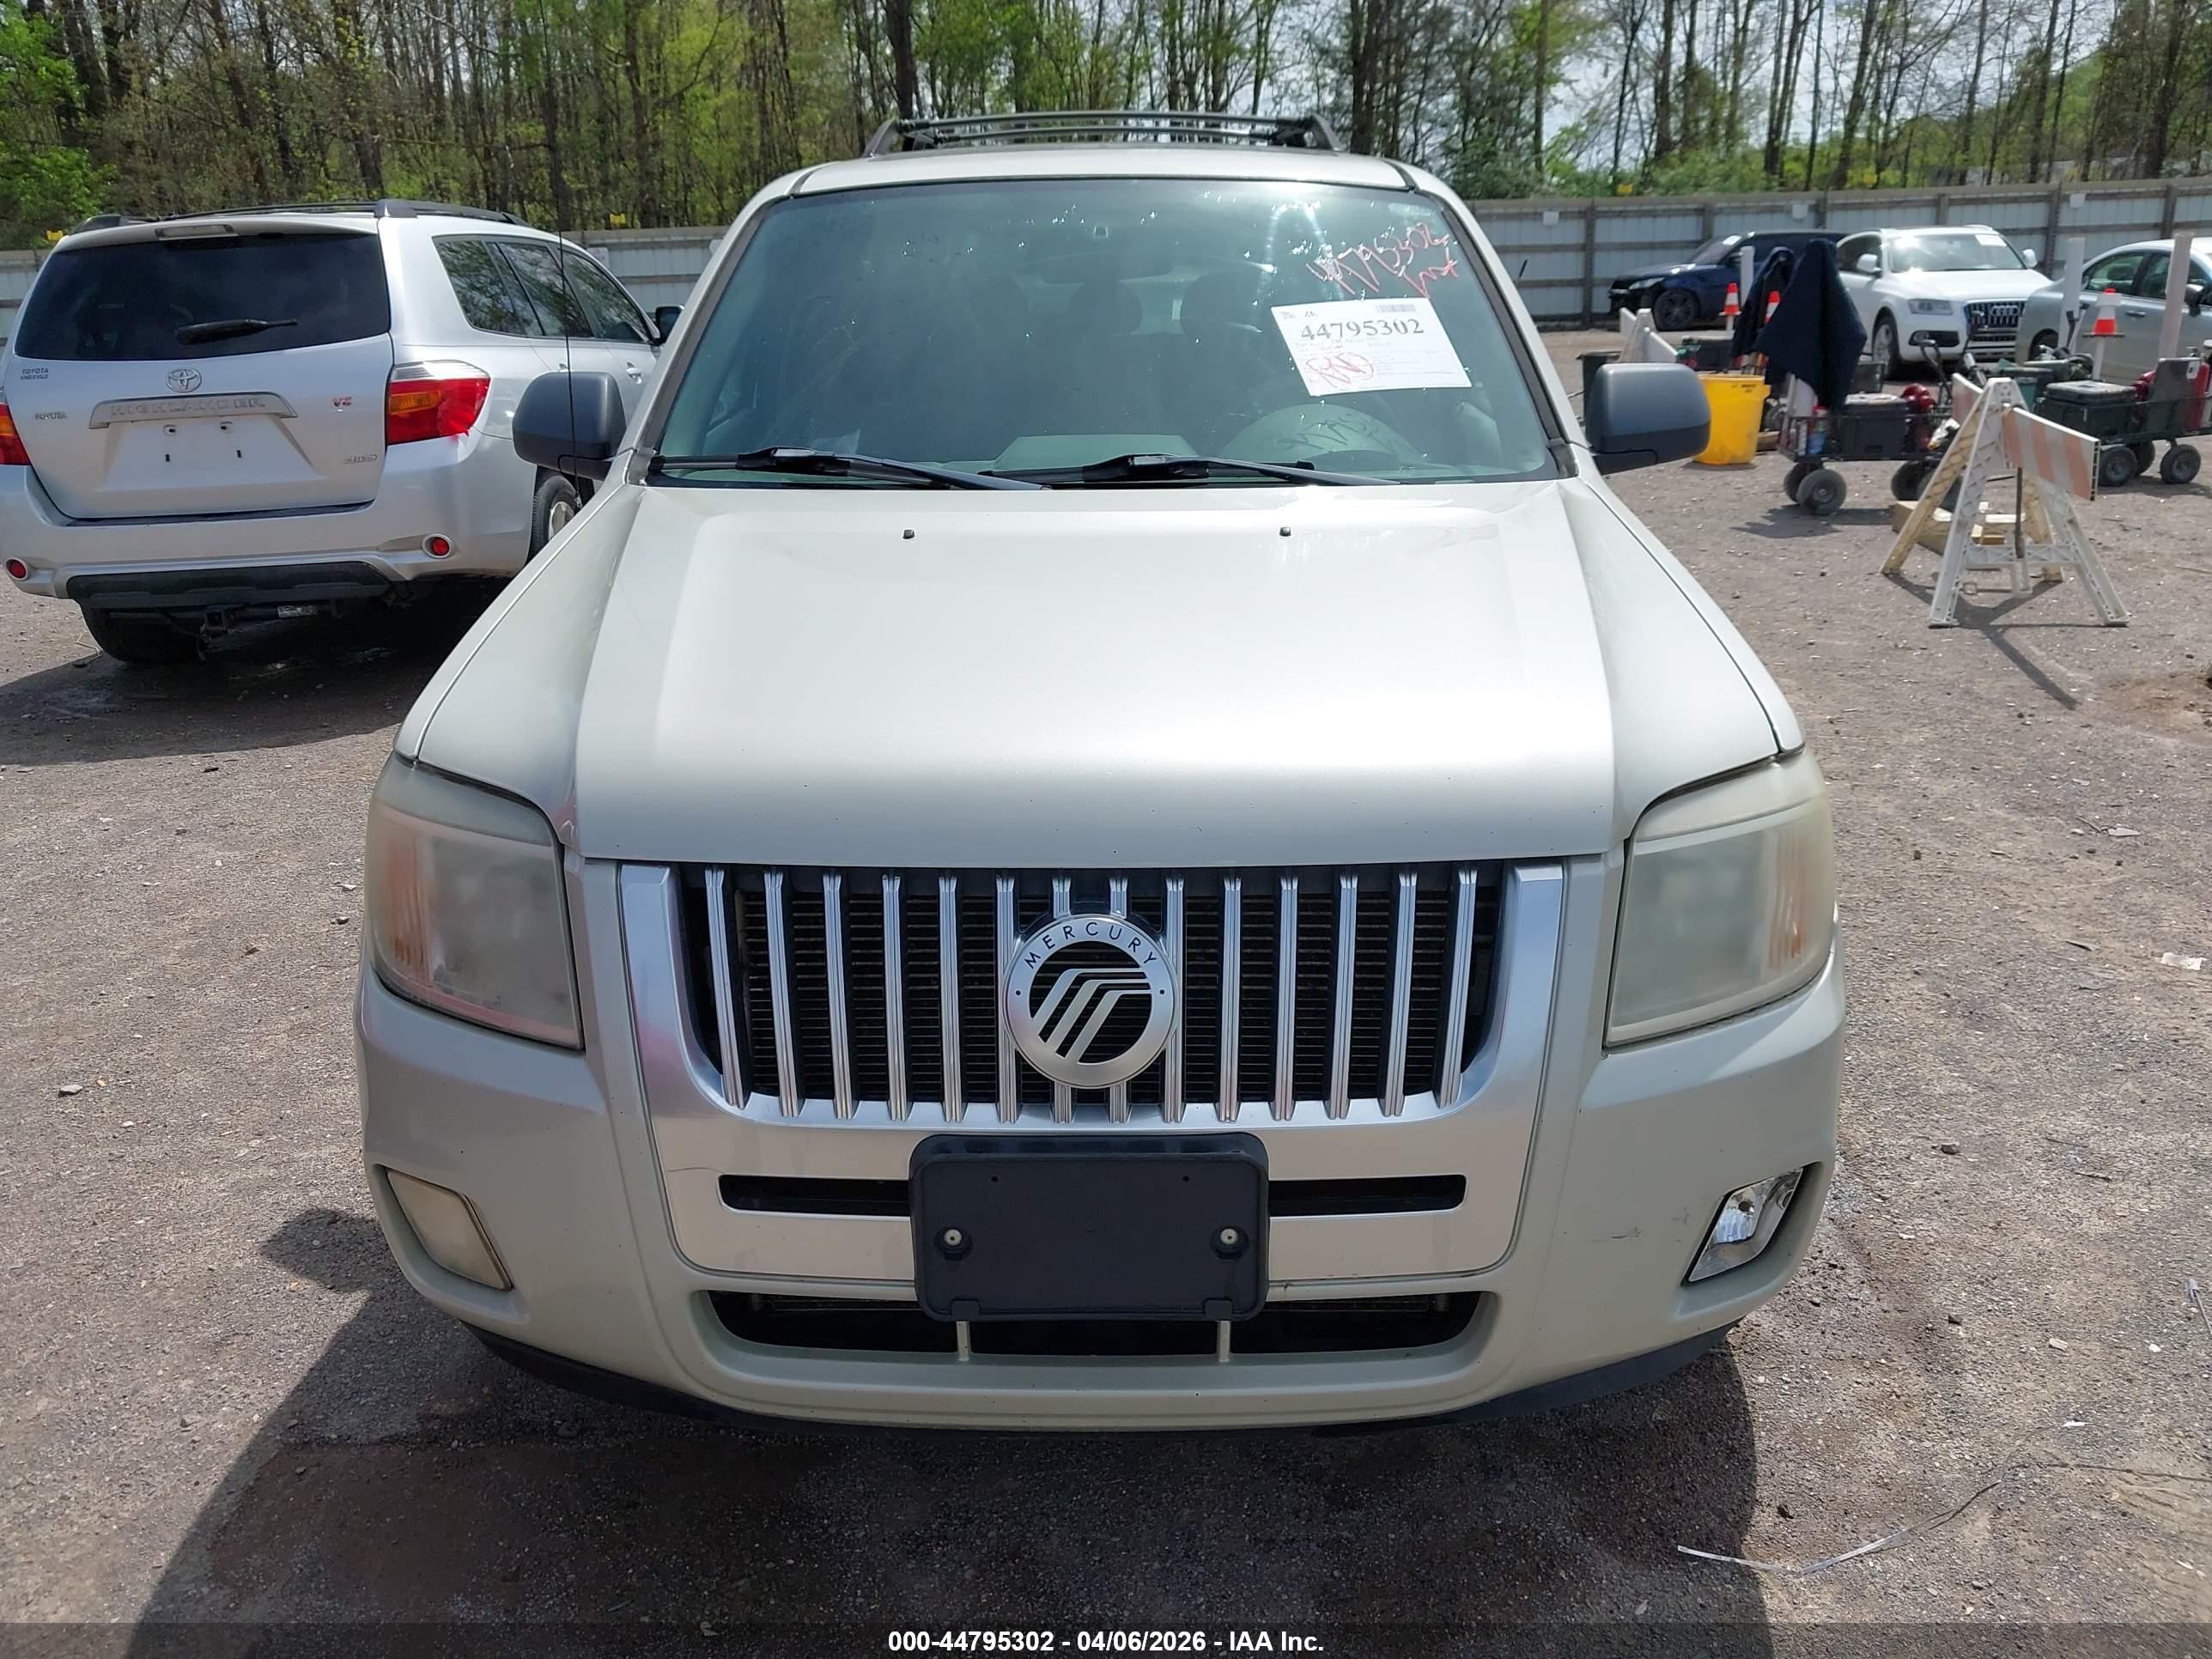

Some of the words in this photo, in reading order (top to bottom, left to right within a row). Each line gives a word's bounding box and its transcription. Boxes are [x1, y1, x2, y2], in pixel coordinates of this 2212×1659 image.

[1301, 319, 1425, 340] 44795302
[110, 398, 266, 416] HIGHLANDER
[1024, 921, 1158, 969] MERCURY
